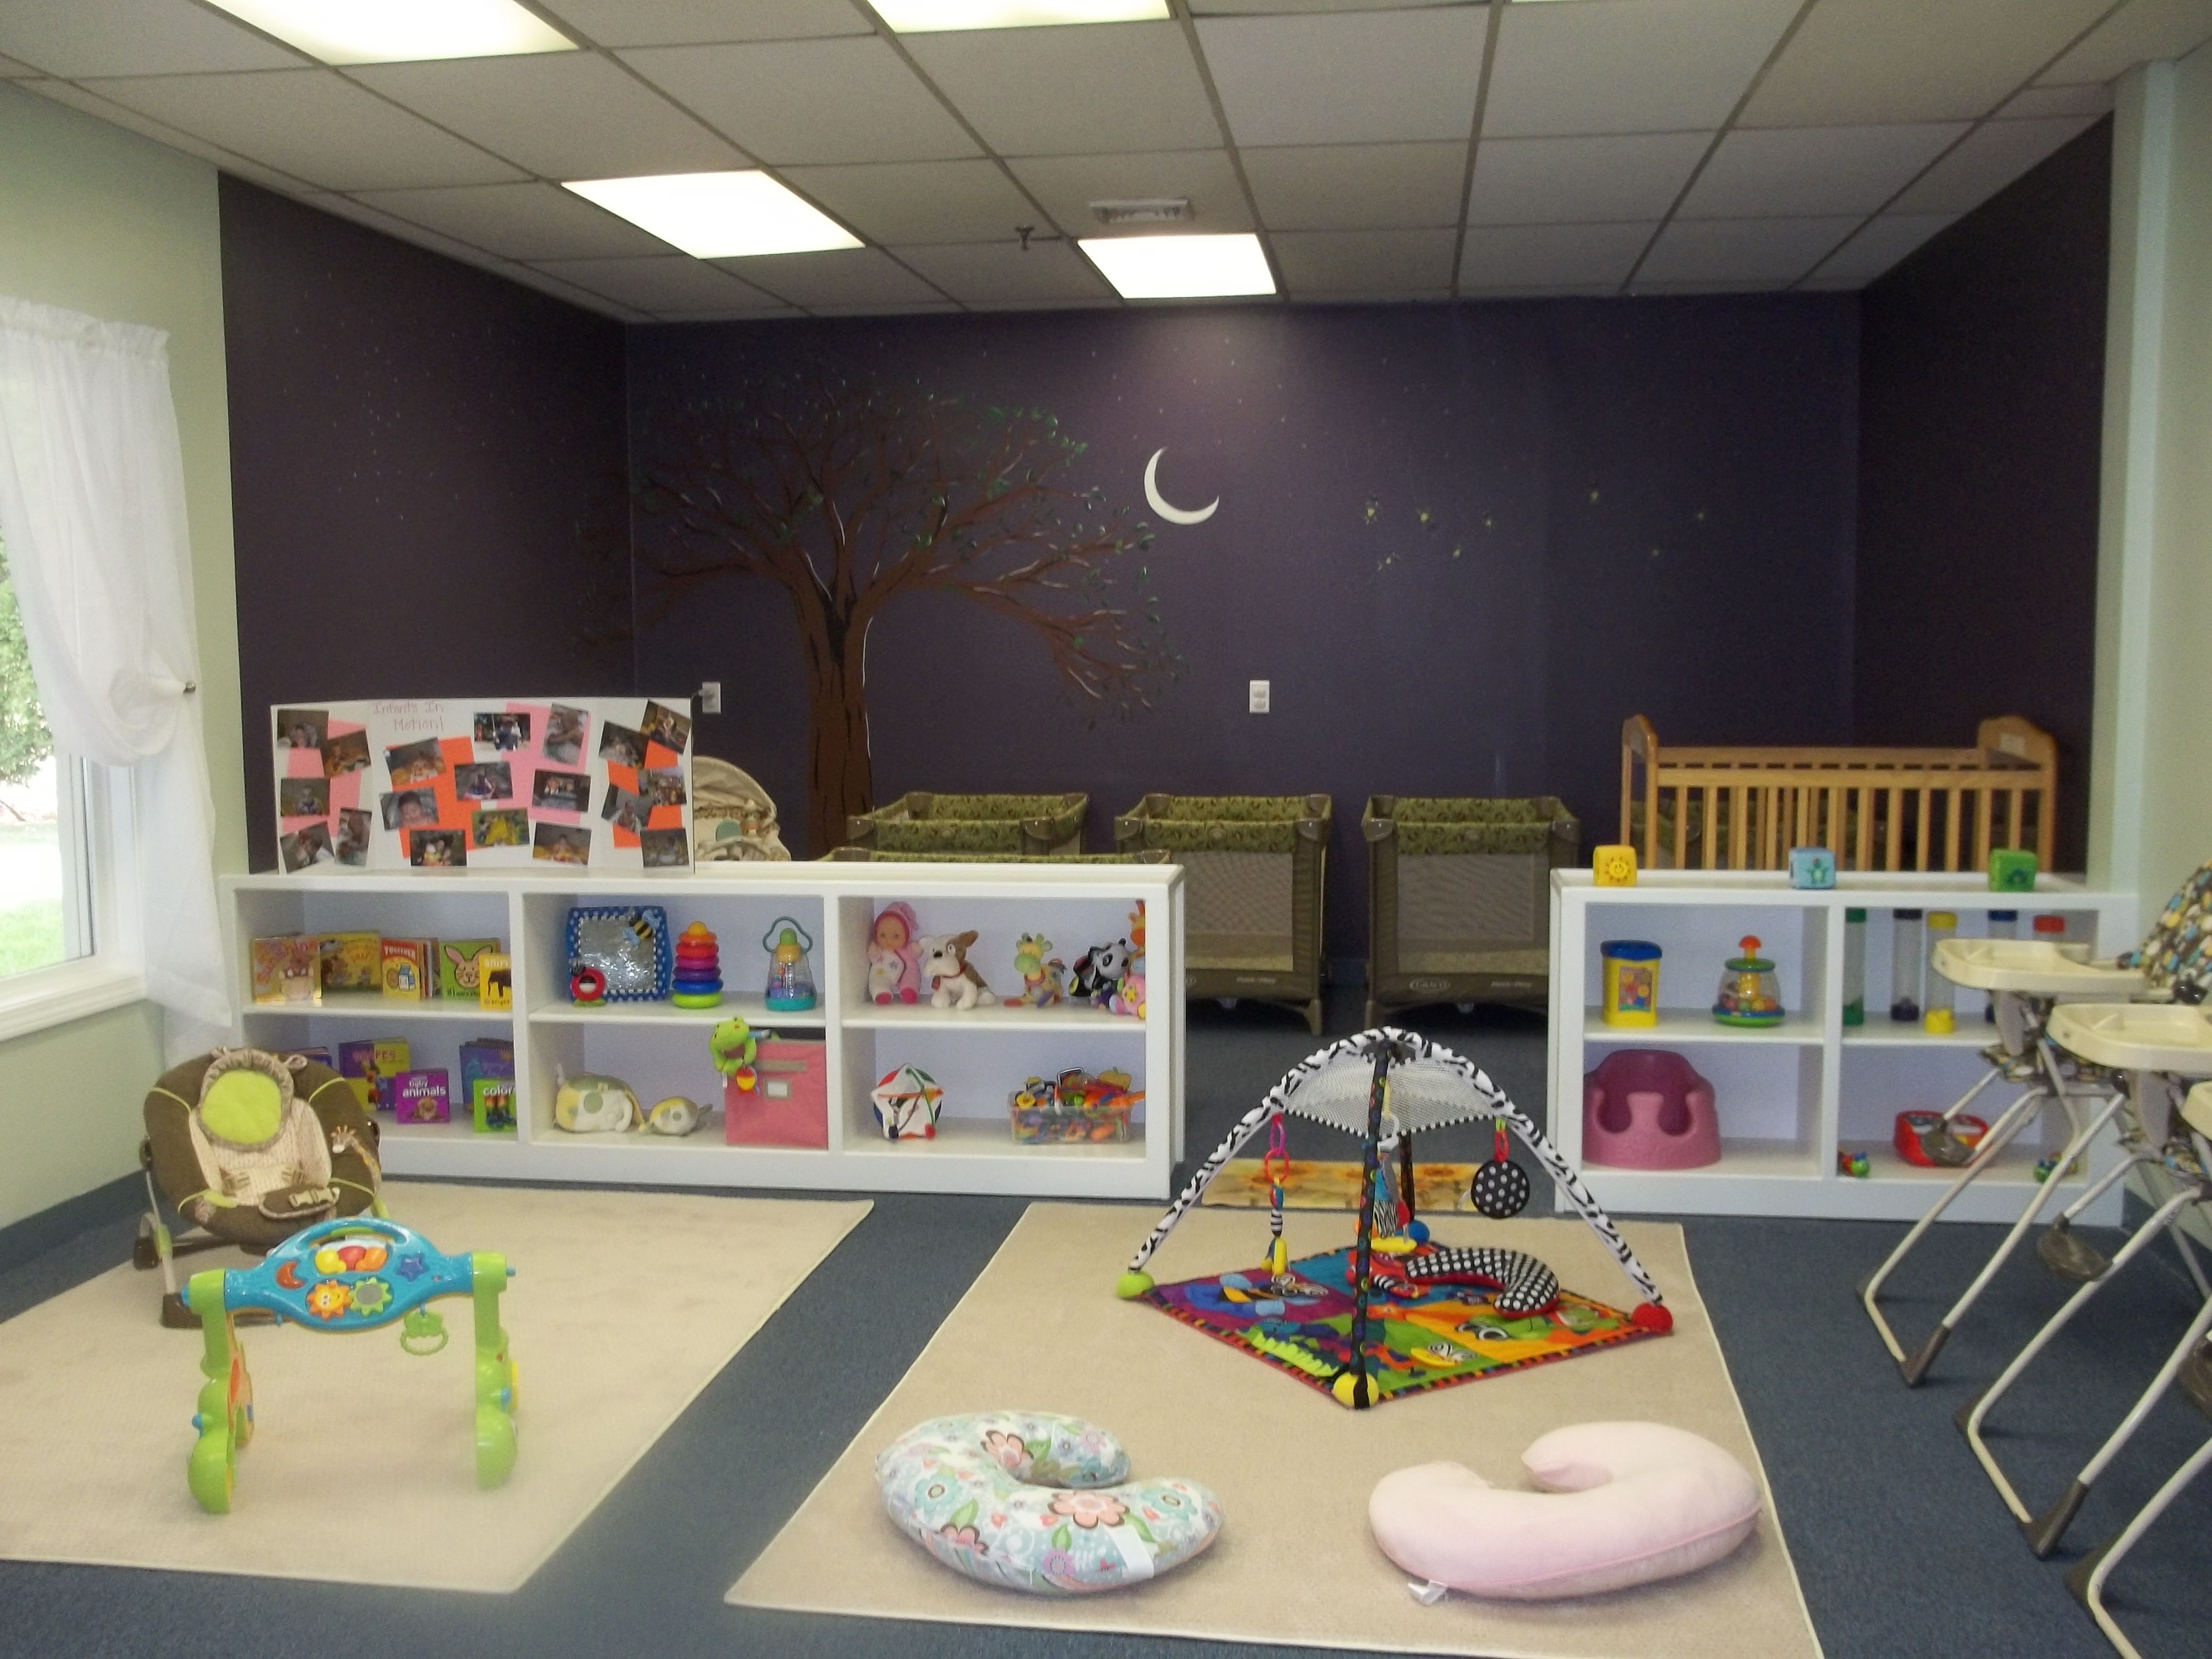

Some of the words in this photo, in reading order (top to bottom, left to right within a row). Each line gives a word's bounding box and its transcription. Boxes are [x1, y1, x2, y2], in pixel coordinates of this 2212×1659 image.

[484, 956, 509, 967] anim
[402, 1085, 446, 1098] animals
[483, 1085, 513, 1096] color
